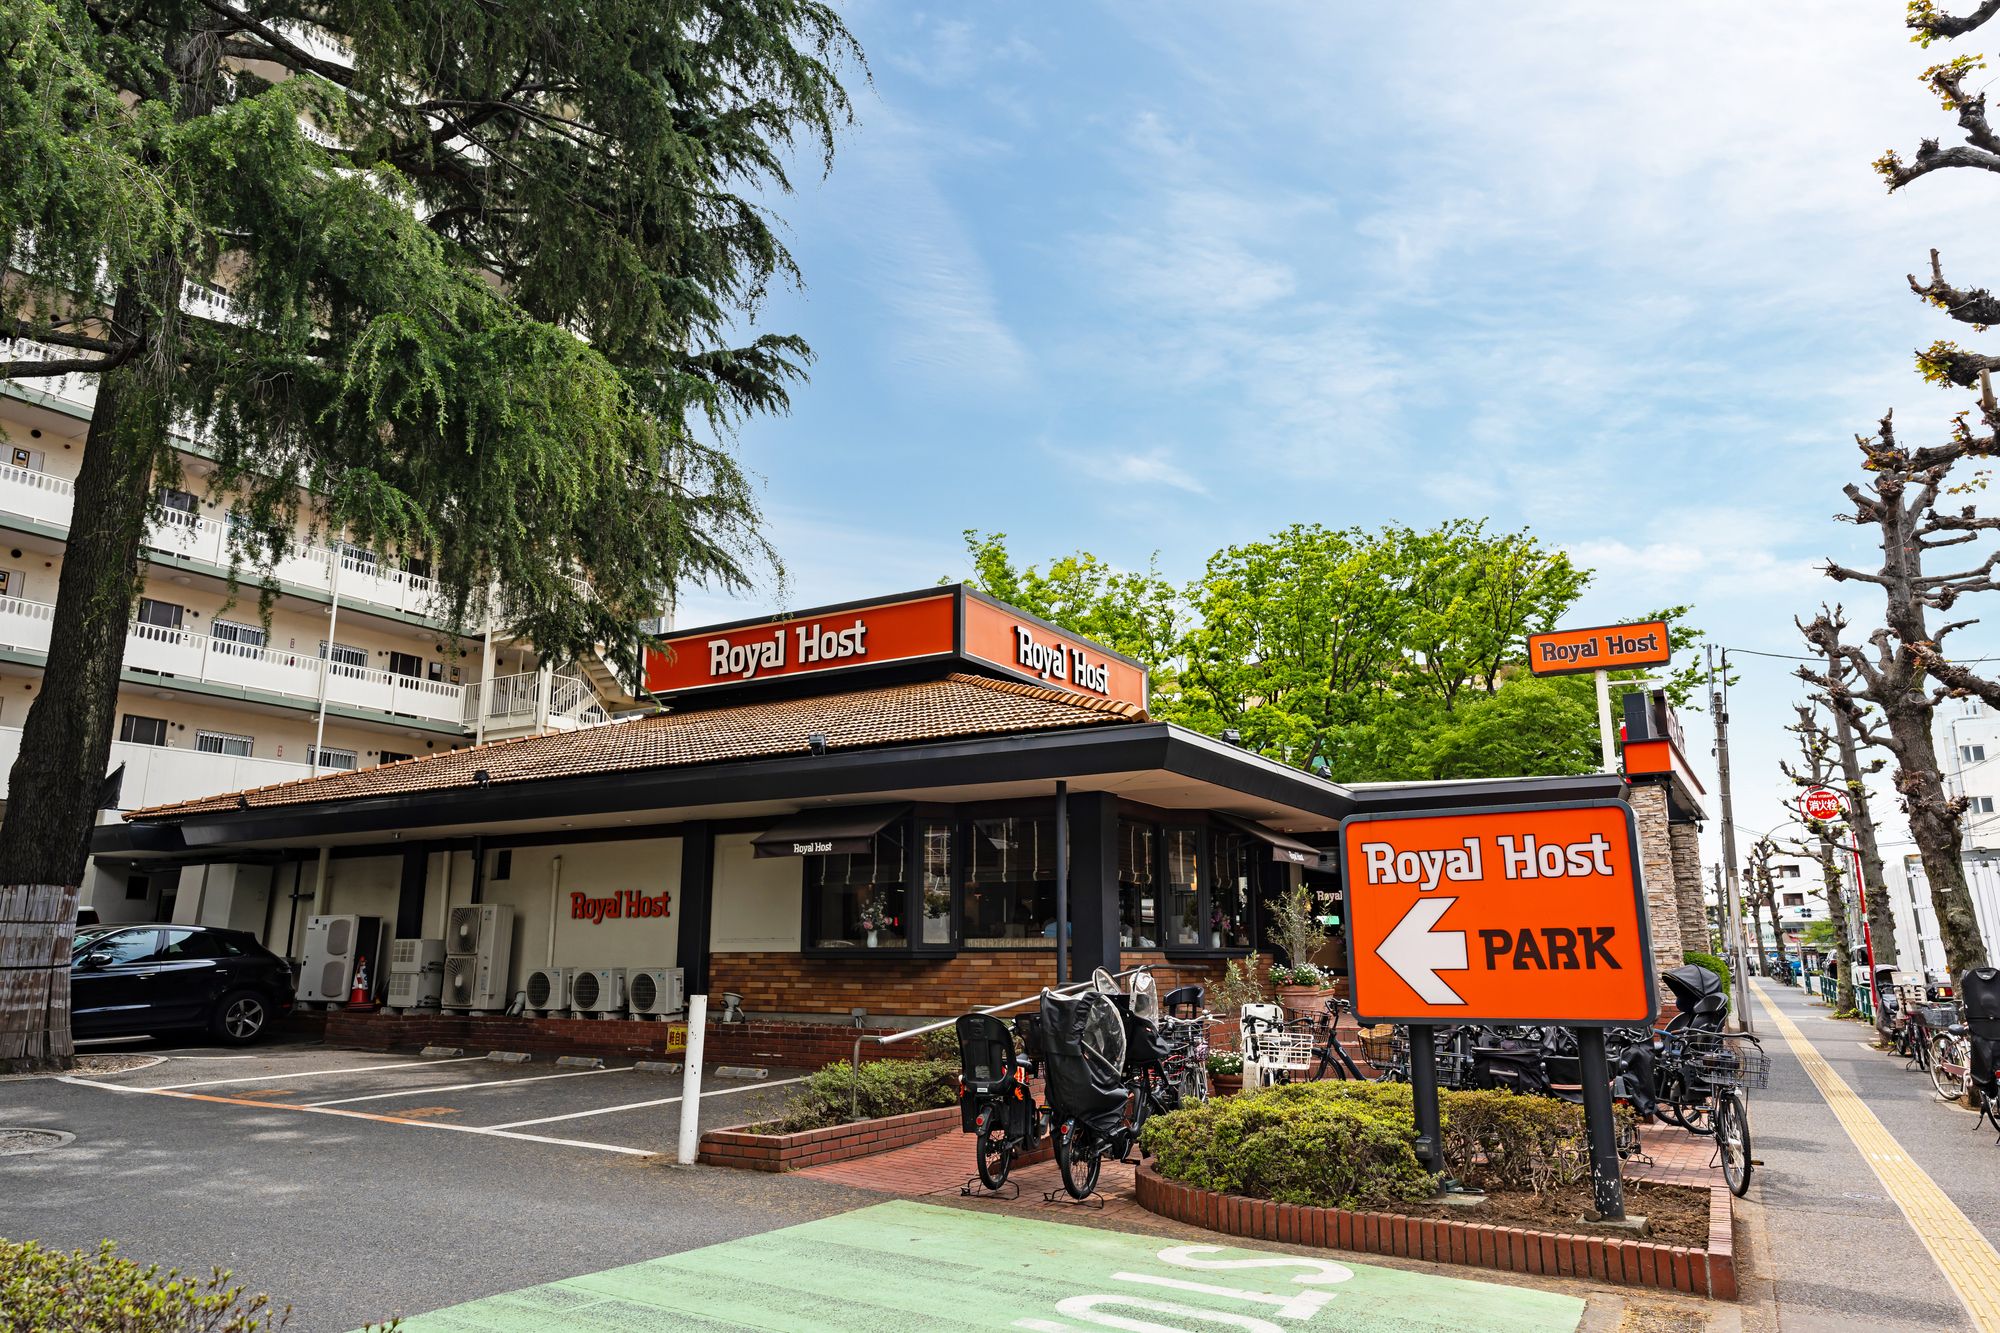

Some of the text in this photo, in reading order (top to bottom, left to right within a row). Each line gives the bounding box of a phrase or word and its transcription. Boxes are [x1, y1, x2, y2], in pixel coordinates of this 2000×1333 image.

[708, 619, 867, 679] Royal Host
[1015, 625, 1110, 696] Royal Host
[1539, 632, 1659, 663] Royal Host
[1808, 799, 1837, 812] 消火栓
[793, 841, 833, 854] Royal Host
[1361, 833, 1615, 892] Royal Host
[570, 889, 671, 925] Royal Host
[1316, 890, 1343, 903] Royal
[1478, 926, 1623, 971] PARK
